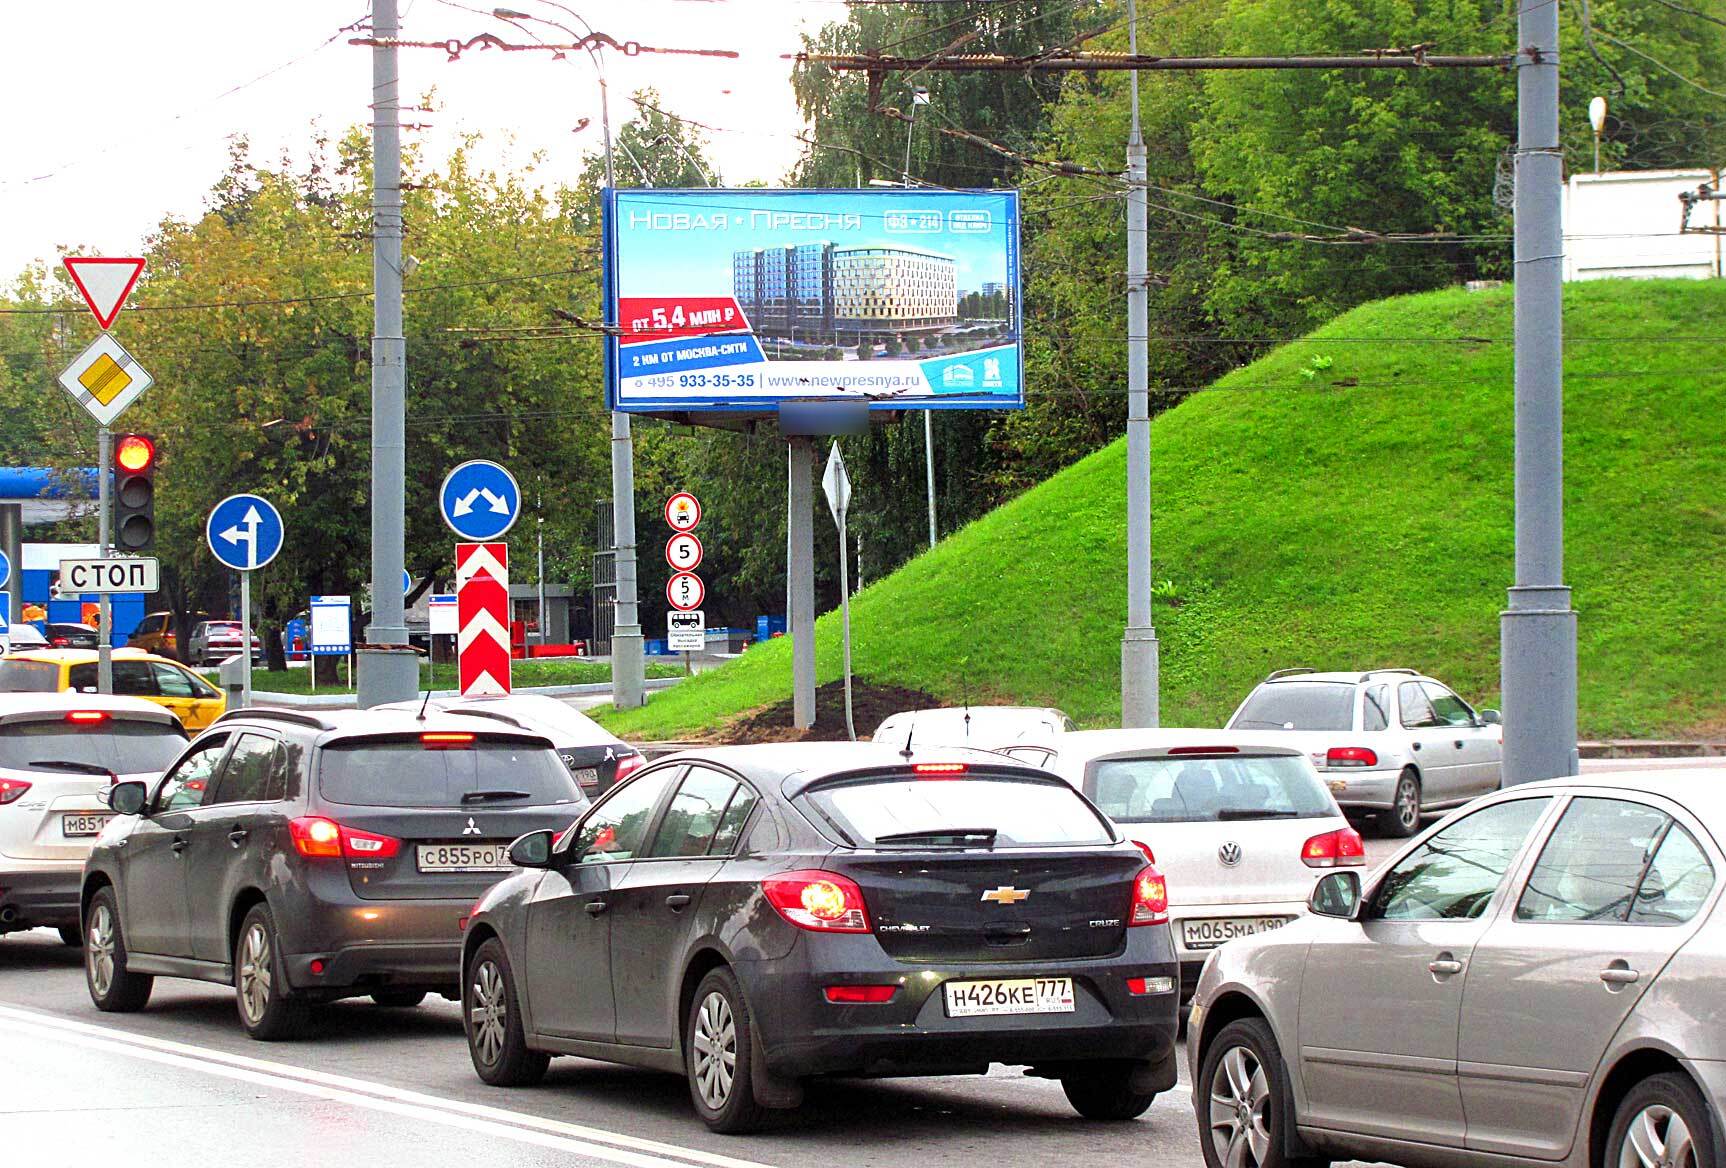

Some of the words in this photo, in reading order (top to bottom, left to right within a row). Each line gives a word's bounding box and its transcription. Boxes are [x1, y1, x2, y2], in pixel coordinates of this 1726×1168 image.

[651, 305, 686, 332] 5,4
[689, 309, 722, 326] МЛН
[632, 356, 640, 367] 2
[642, 353, 659, 366] КМ
[661, 351, 674, 363] ОТ
[676, 342, 748, 361] МОСКВА-СИТИ
[679, 374, 754, 387] 933-35-35
[767, 375, 920, 388] www.newpresnya.ru
[679, 544, 690, 559] 5
[71, 564, 145, 587] СТОП
[681, 581, 689, 594] 5
[68, 817, 110, 831] М851
[425, 847, 494, 865] С855РО
[880, 924, 930, 932] CHEVLET
[1089, 919, 1120, 928] CRUZE
[1189, 922, 1255, 940] М065МА
[953, 983, 1034, 1007] Н426КЕ
[1036, 979, 1066, 997] 777
